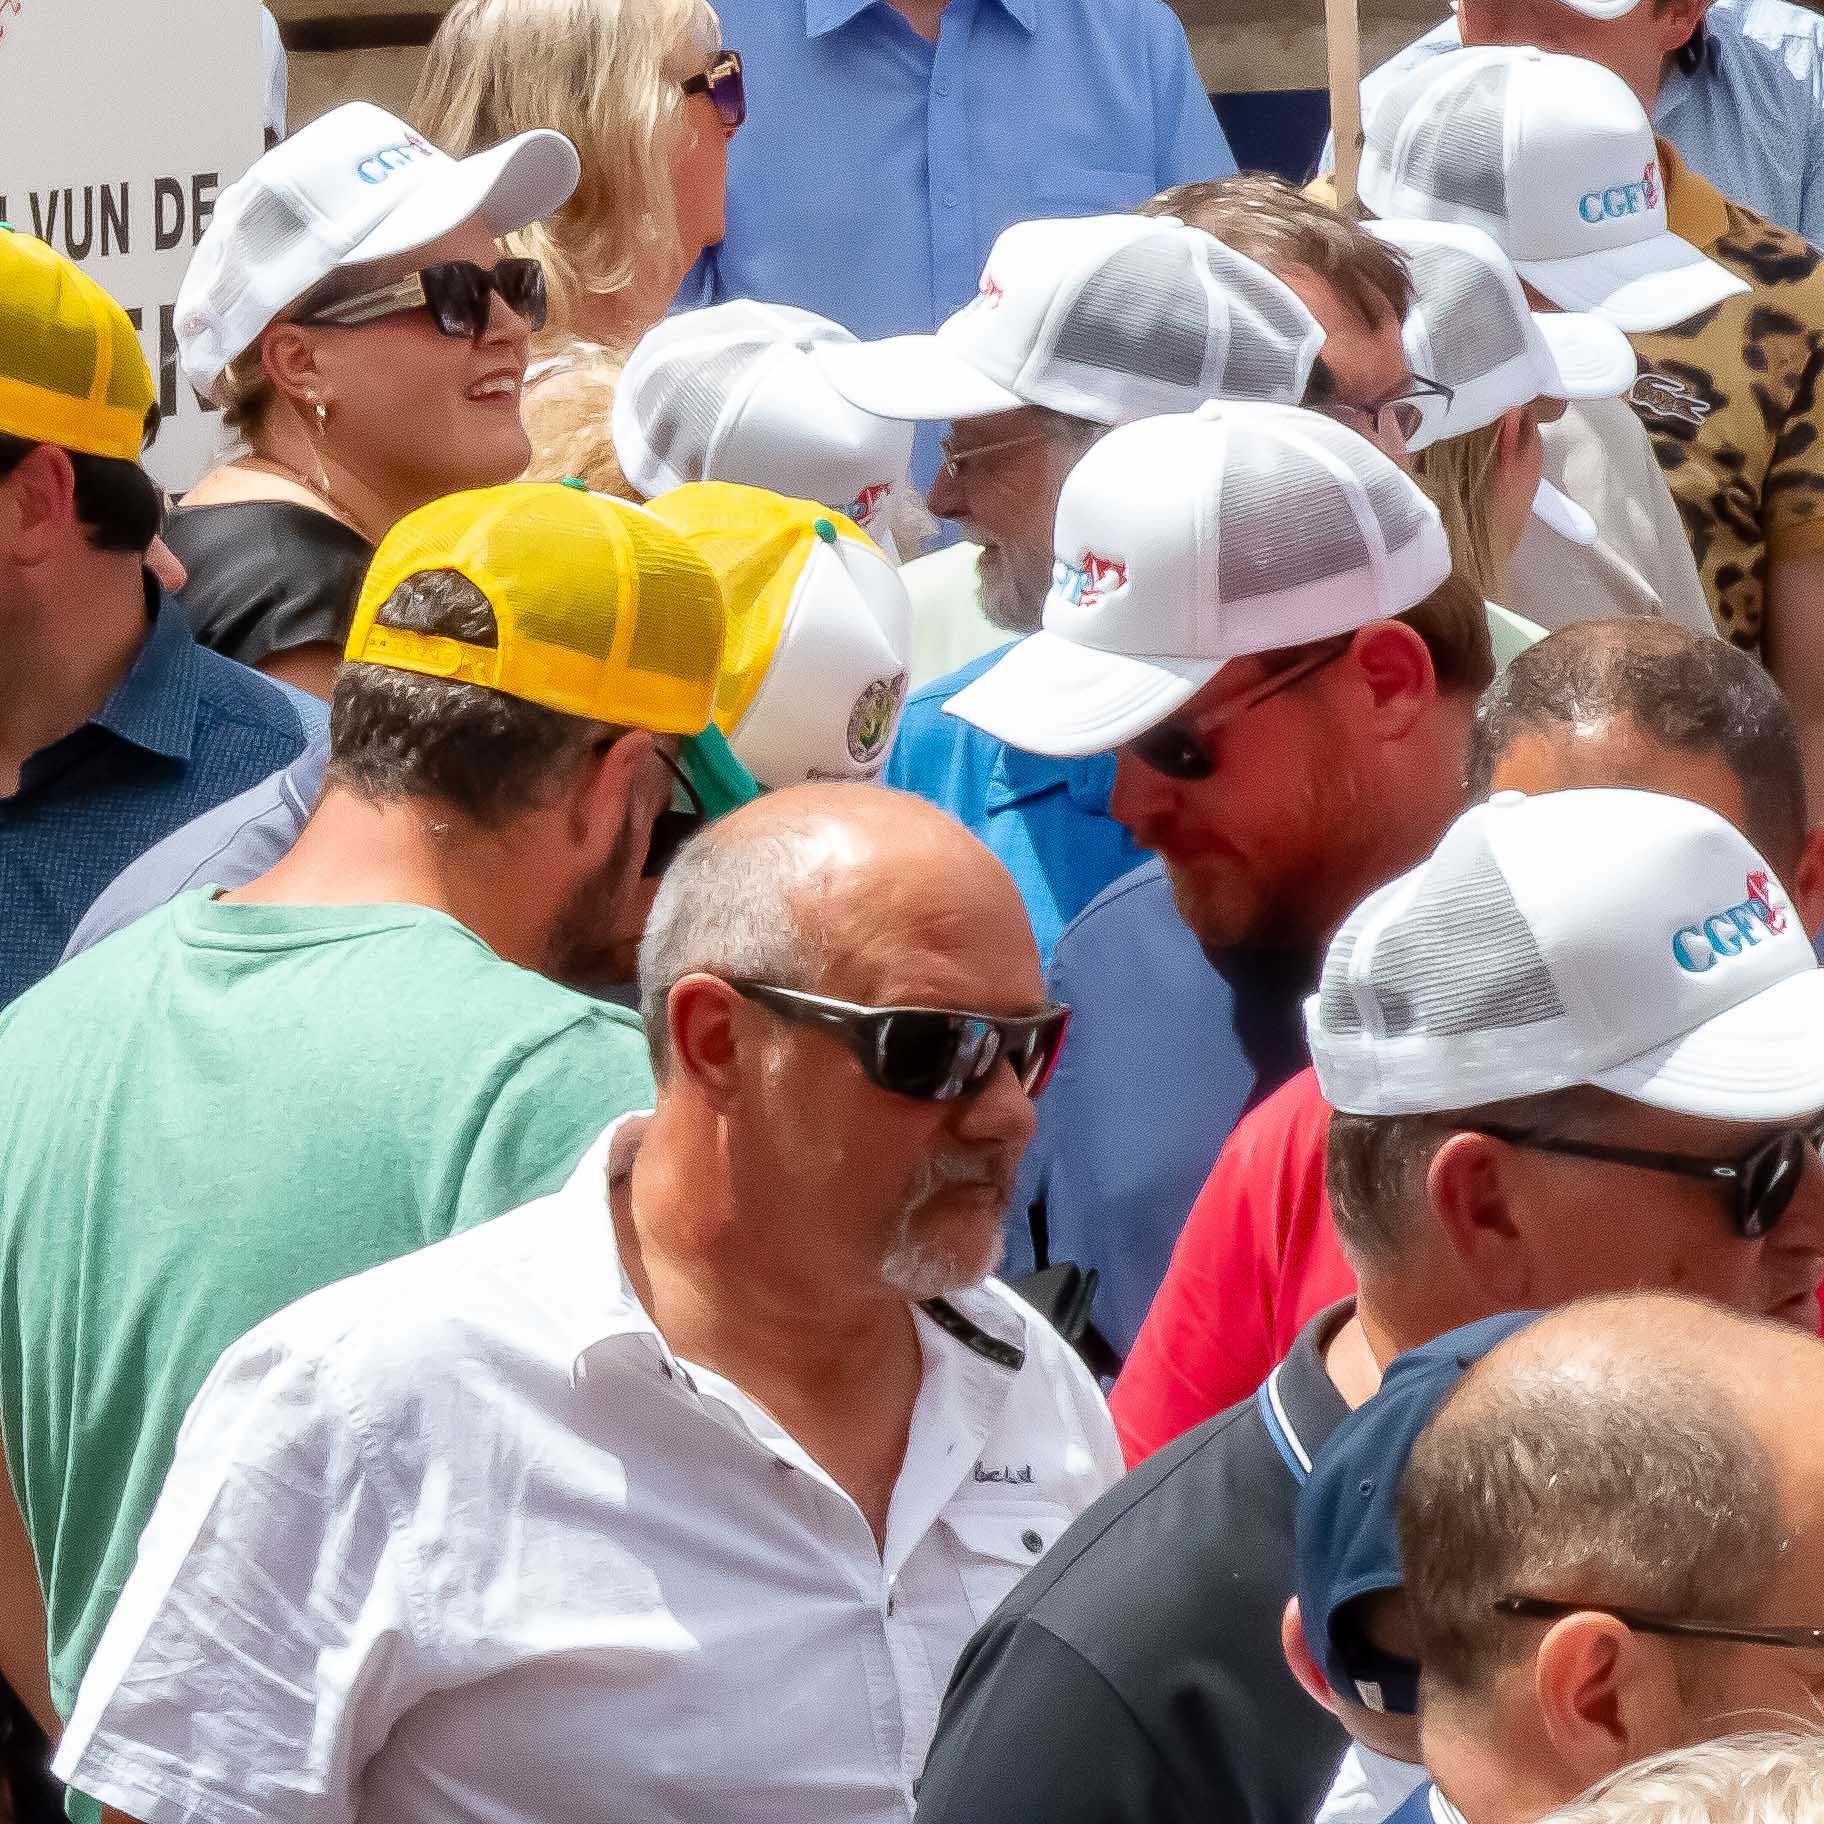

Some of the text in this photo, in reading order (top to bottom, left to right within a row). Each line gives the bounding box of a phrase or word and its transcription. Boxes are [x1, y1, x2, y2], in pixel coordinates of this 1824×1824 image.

[29, 171, 221, 261] VUN DE
[1672, 899, 1776, 973] CGFP
